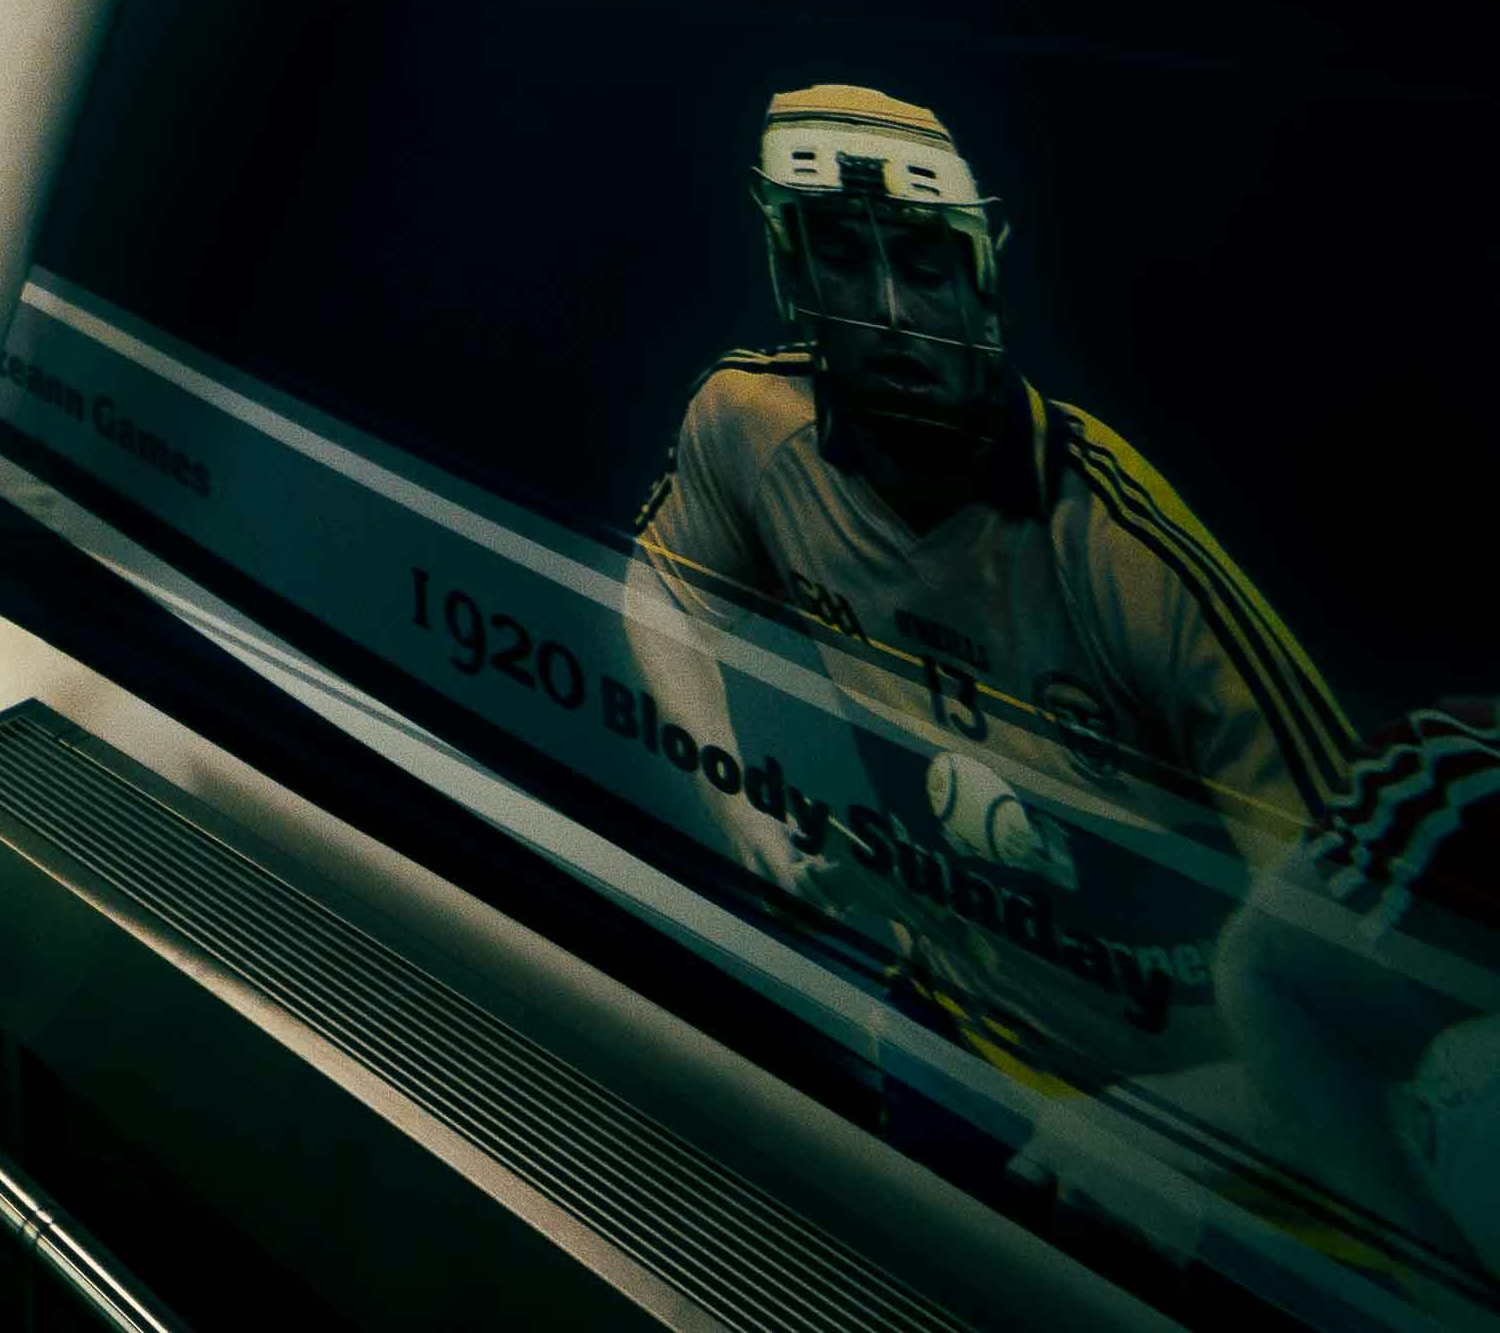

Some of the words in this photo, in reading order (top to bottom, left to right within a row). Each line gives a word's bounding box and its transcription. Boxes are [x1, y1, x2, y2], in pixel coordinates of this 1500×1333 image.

[93, 394, 211, 498] Games
[411, 565, 585, 711] 1920
[602, 678, 831, 854] Bloody
[851, 803, 1172, 1032] Sunday
